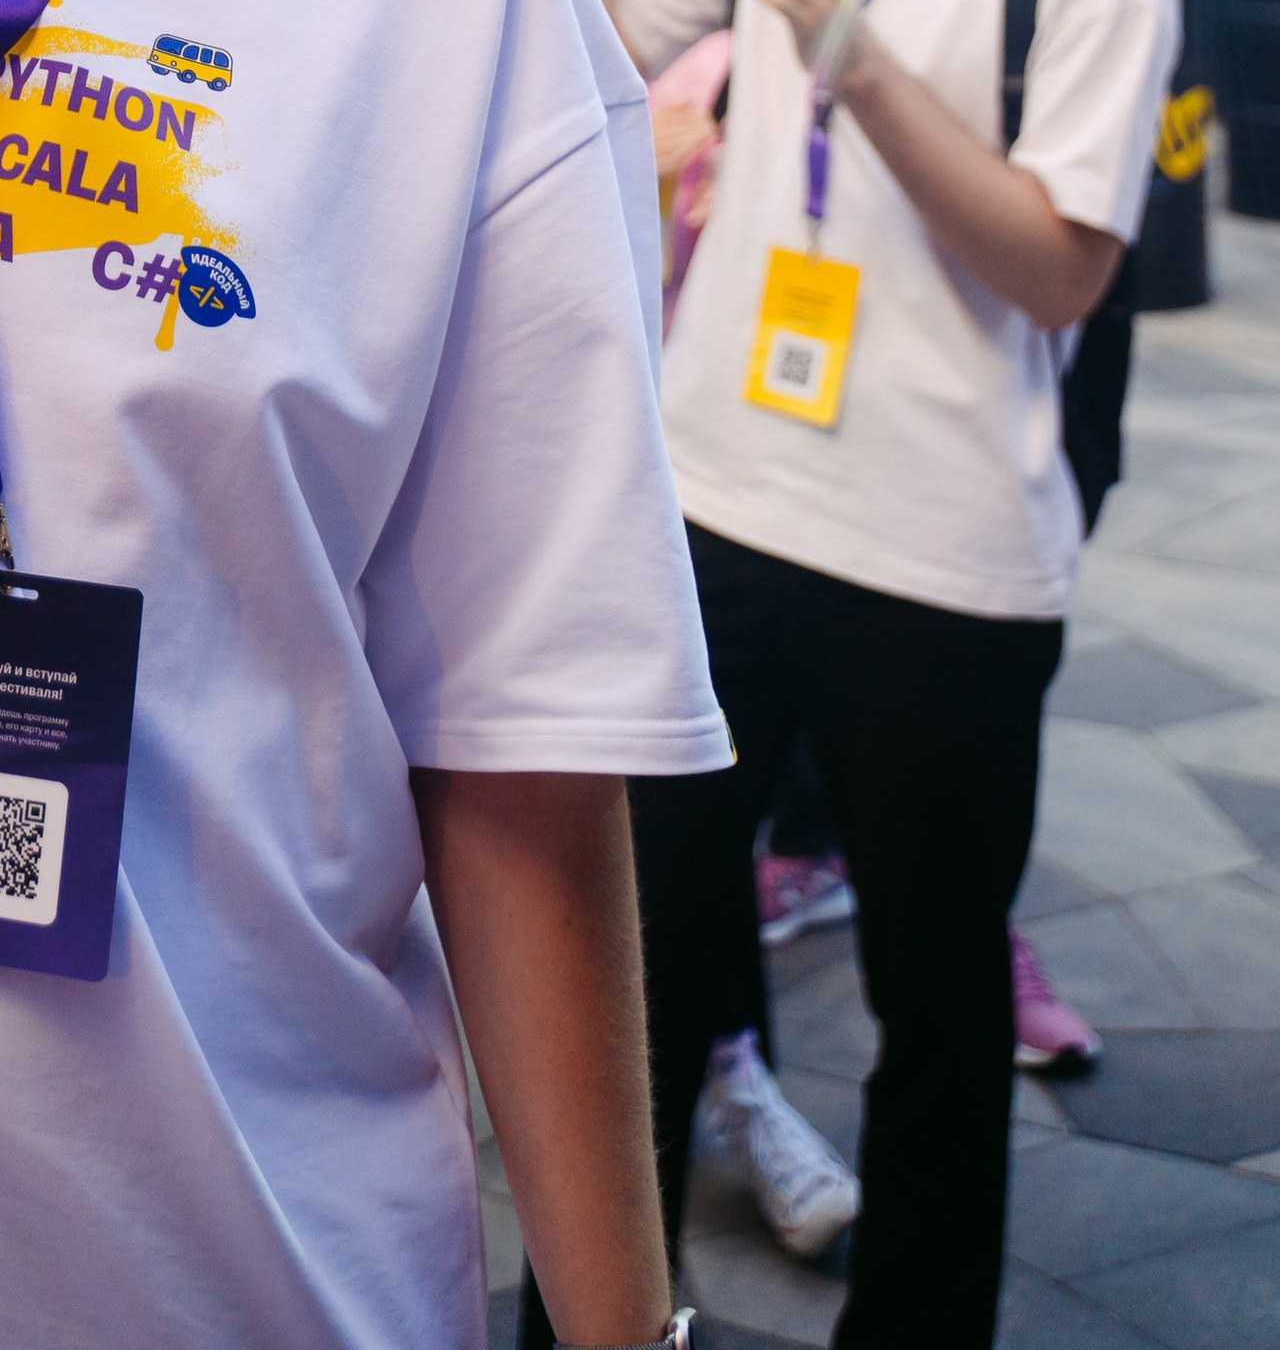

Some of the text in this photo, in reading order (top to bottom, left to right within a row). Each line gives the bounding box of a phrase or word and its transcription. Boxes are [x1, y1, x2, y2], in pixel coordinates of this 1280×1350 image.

[92, 240, 183, 303] C#
[190, 253, 251, 310] ИДЕАЛЬНЫЙ
[209, 269, 232, 294] КОД
[14, 666, 22, 676] и
[25, 667, 77, 684] вступай
[5, 722, 19, 731] его
[20, 724, 42, 735] карту
[23, 712, 69, 727] программу
